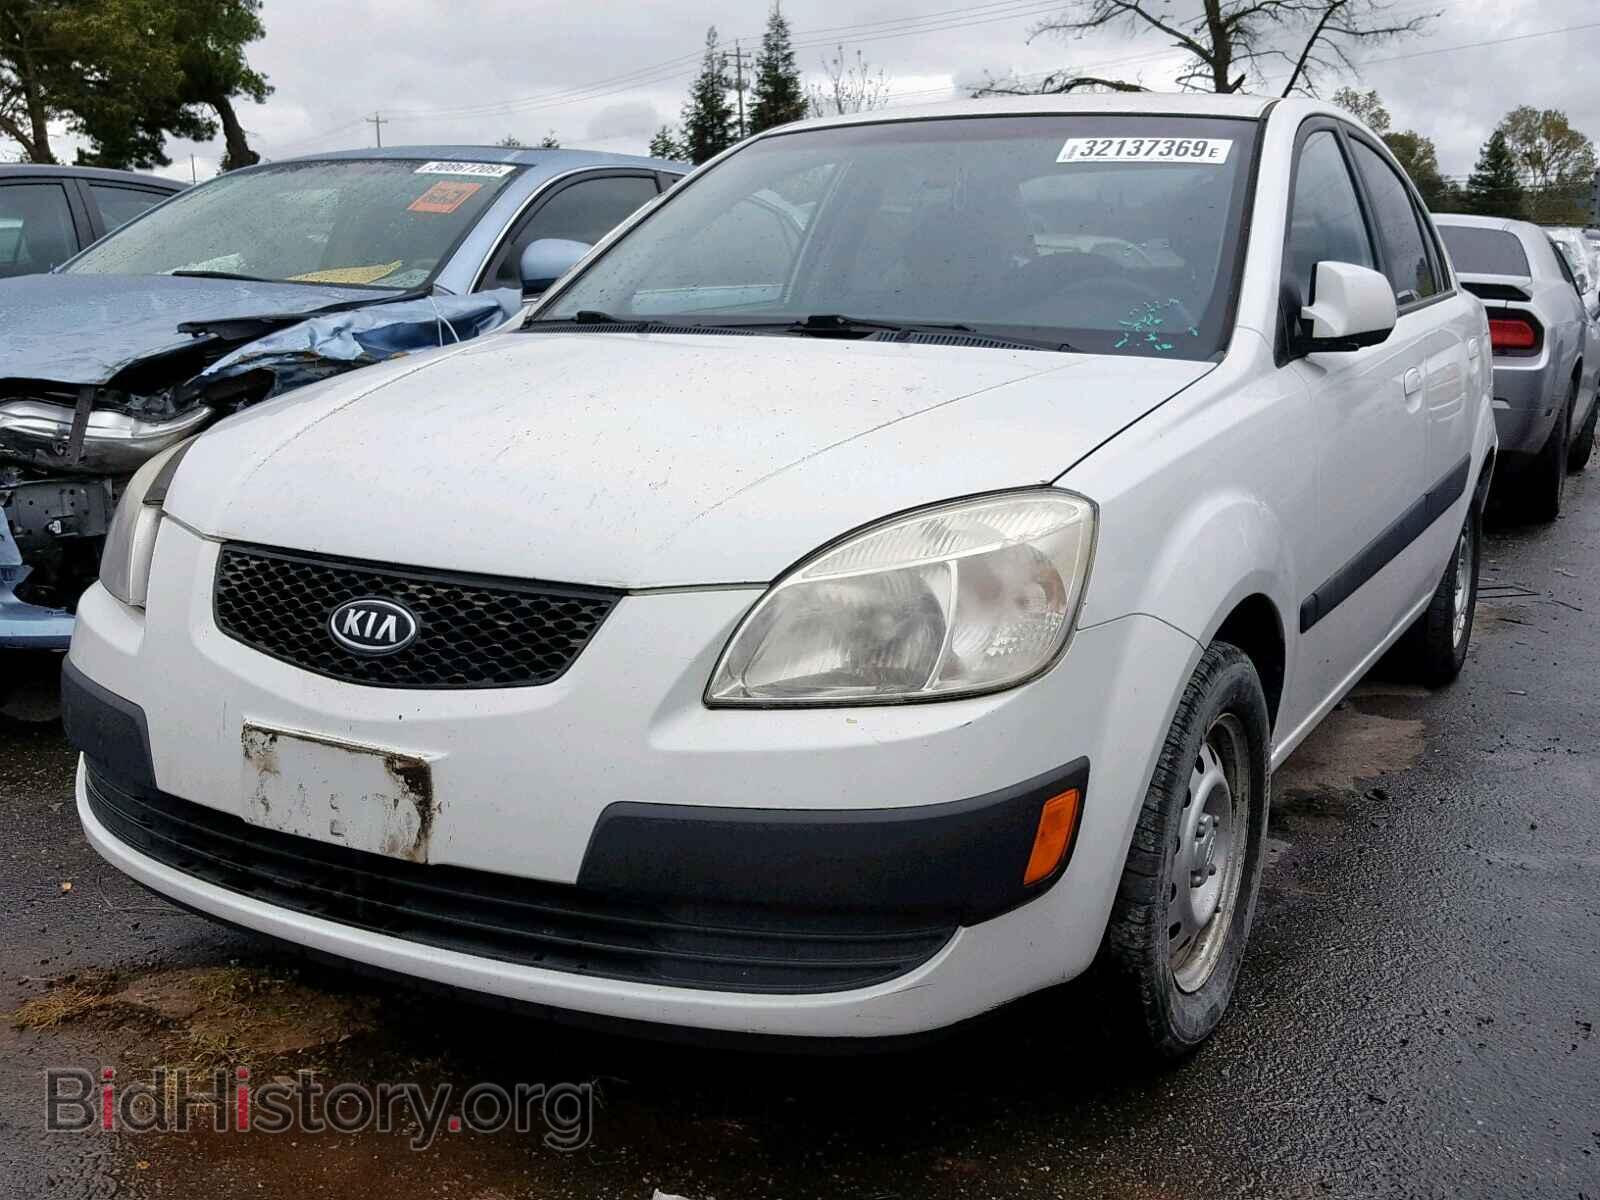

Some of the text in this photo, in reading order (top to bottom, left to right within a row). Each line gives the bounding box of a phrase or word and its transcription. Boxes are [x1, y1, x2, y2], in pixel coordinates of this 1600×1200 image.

[1080, 139, 1209, 158] 32137369
[1208, 147, 1220, 158] E
[342, 608, 397, 643] KIA
